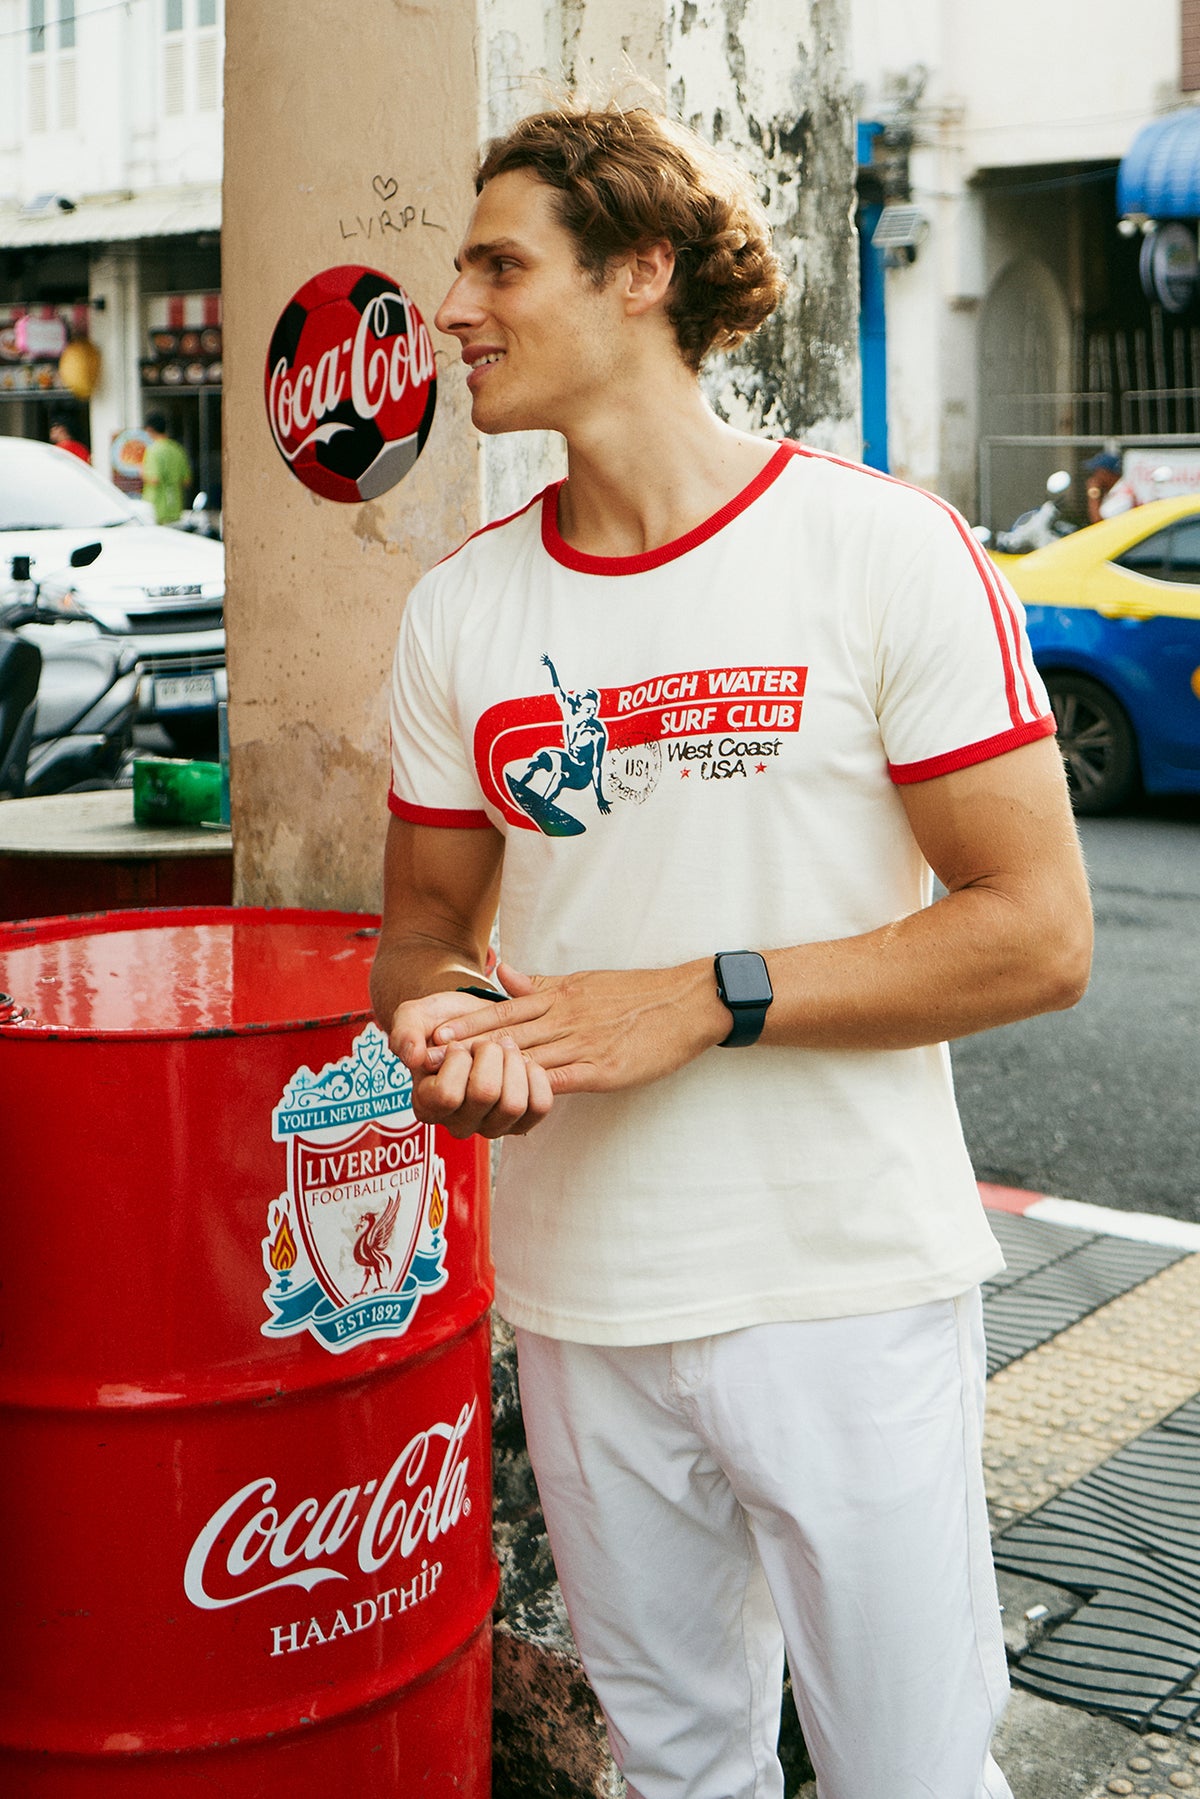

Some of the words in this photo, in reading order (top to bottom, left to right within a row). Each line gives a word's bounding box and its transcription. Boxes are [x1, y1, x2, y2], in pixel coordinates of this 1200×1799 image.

[338, 205, 447, 239] LVRPL
[269, 286, 433, 461] Coca-Cola
[617, 674, 699, 713] ROUGH
[707, 670, 799, 694] WATER
[660, 707, 717, 736] SURF
[726, 705, 796, 728] CLUB
[668, 739, 714, 762] West
[718, 738, 784, 757] Coast
[701, 759, 747, 780] USA
[281, 1112, 328, 1130] YOU'LL
[329, 1102, 372, 1123] NEVER
[372, 1093, 405, 1114] WALK
[305, 1134, 424, 1187] LIVERPOOL
[312, 1178, 386, 1207] FOOTBALL
[389, 1167, 420, 1189] CLUB
[183, 1394, 479, 1610] Coca-Cola
